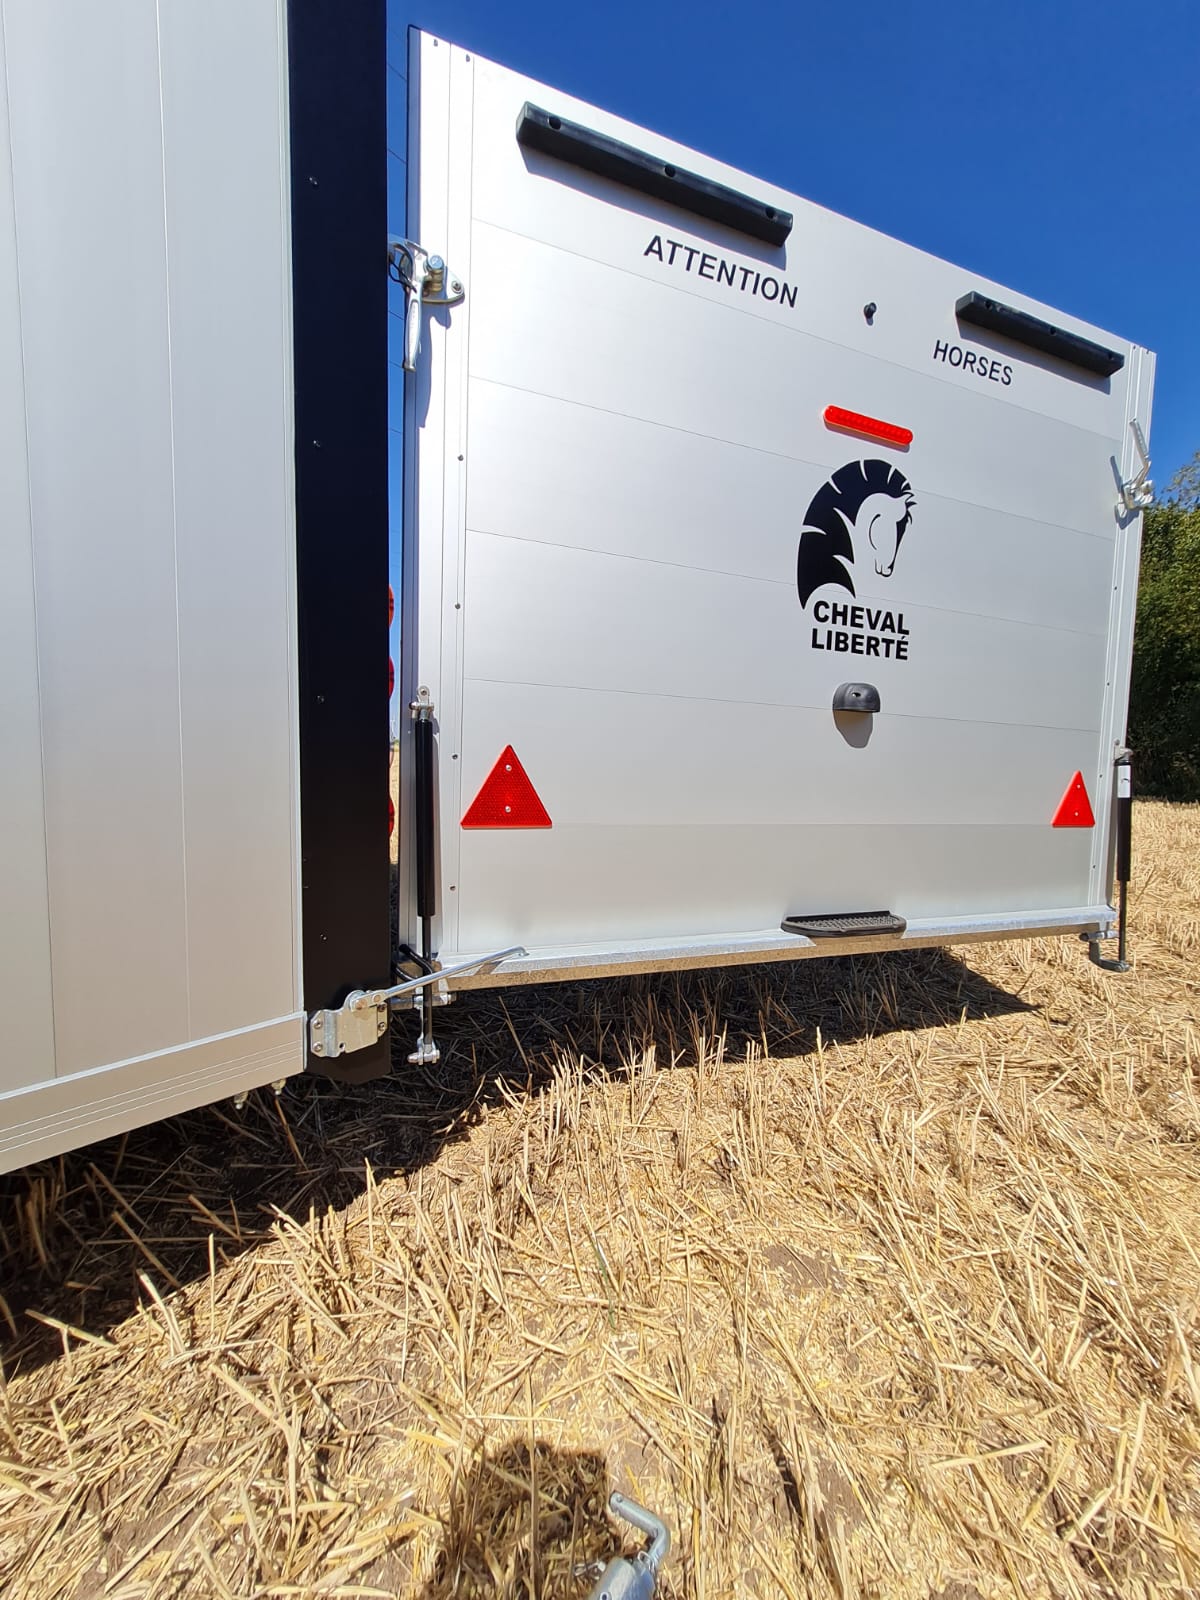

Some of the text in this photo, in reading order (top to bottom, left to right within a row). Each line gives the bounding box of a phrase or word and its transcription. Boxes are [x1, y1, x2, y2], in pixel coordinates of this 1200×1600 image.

[643, 235, 798, 308] ATTENTION
[933, 339, 1014, 386] HORSES
[813, 600, 910, 636] CHEVAL
[811, 627, 909, 661] LIBERTÉ
